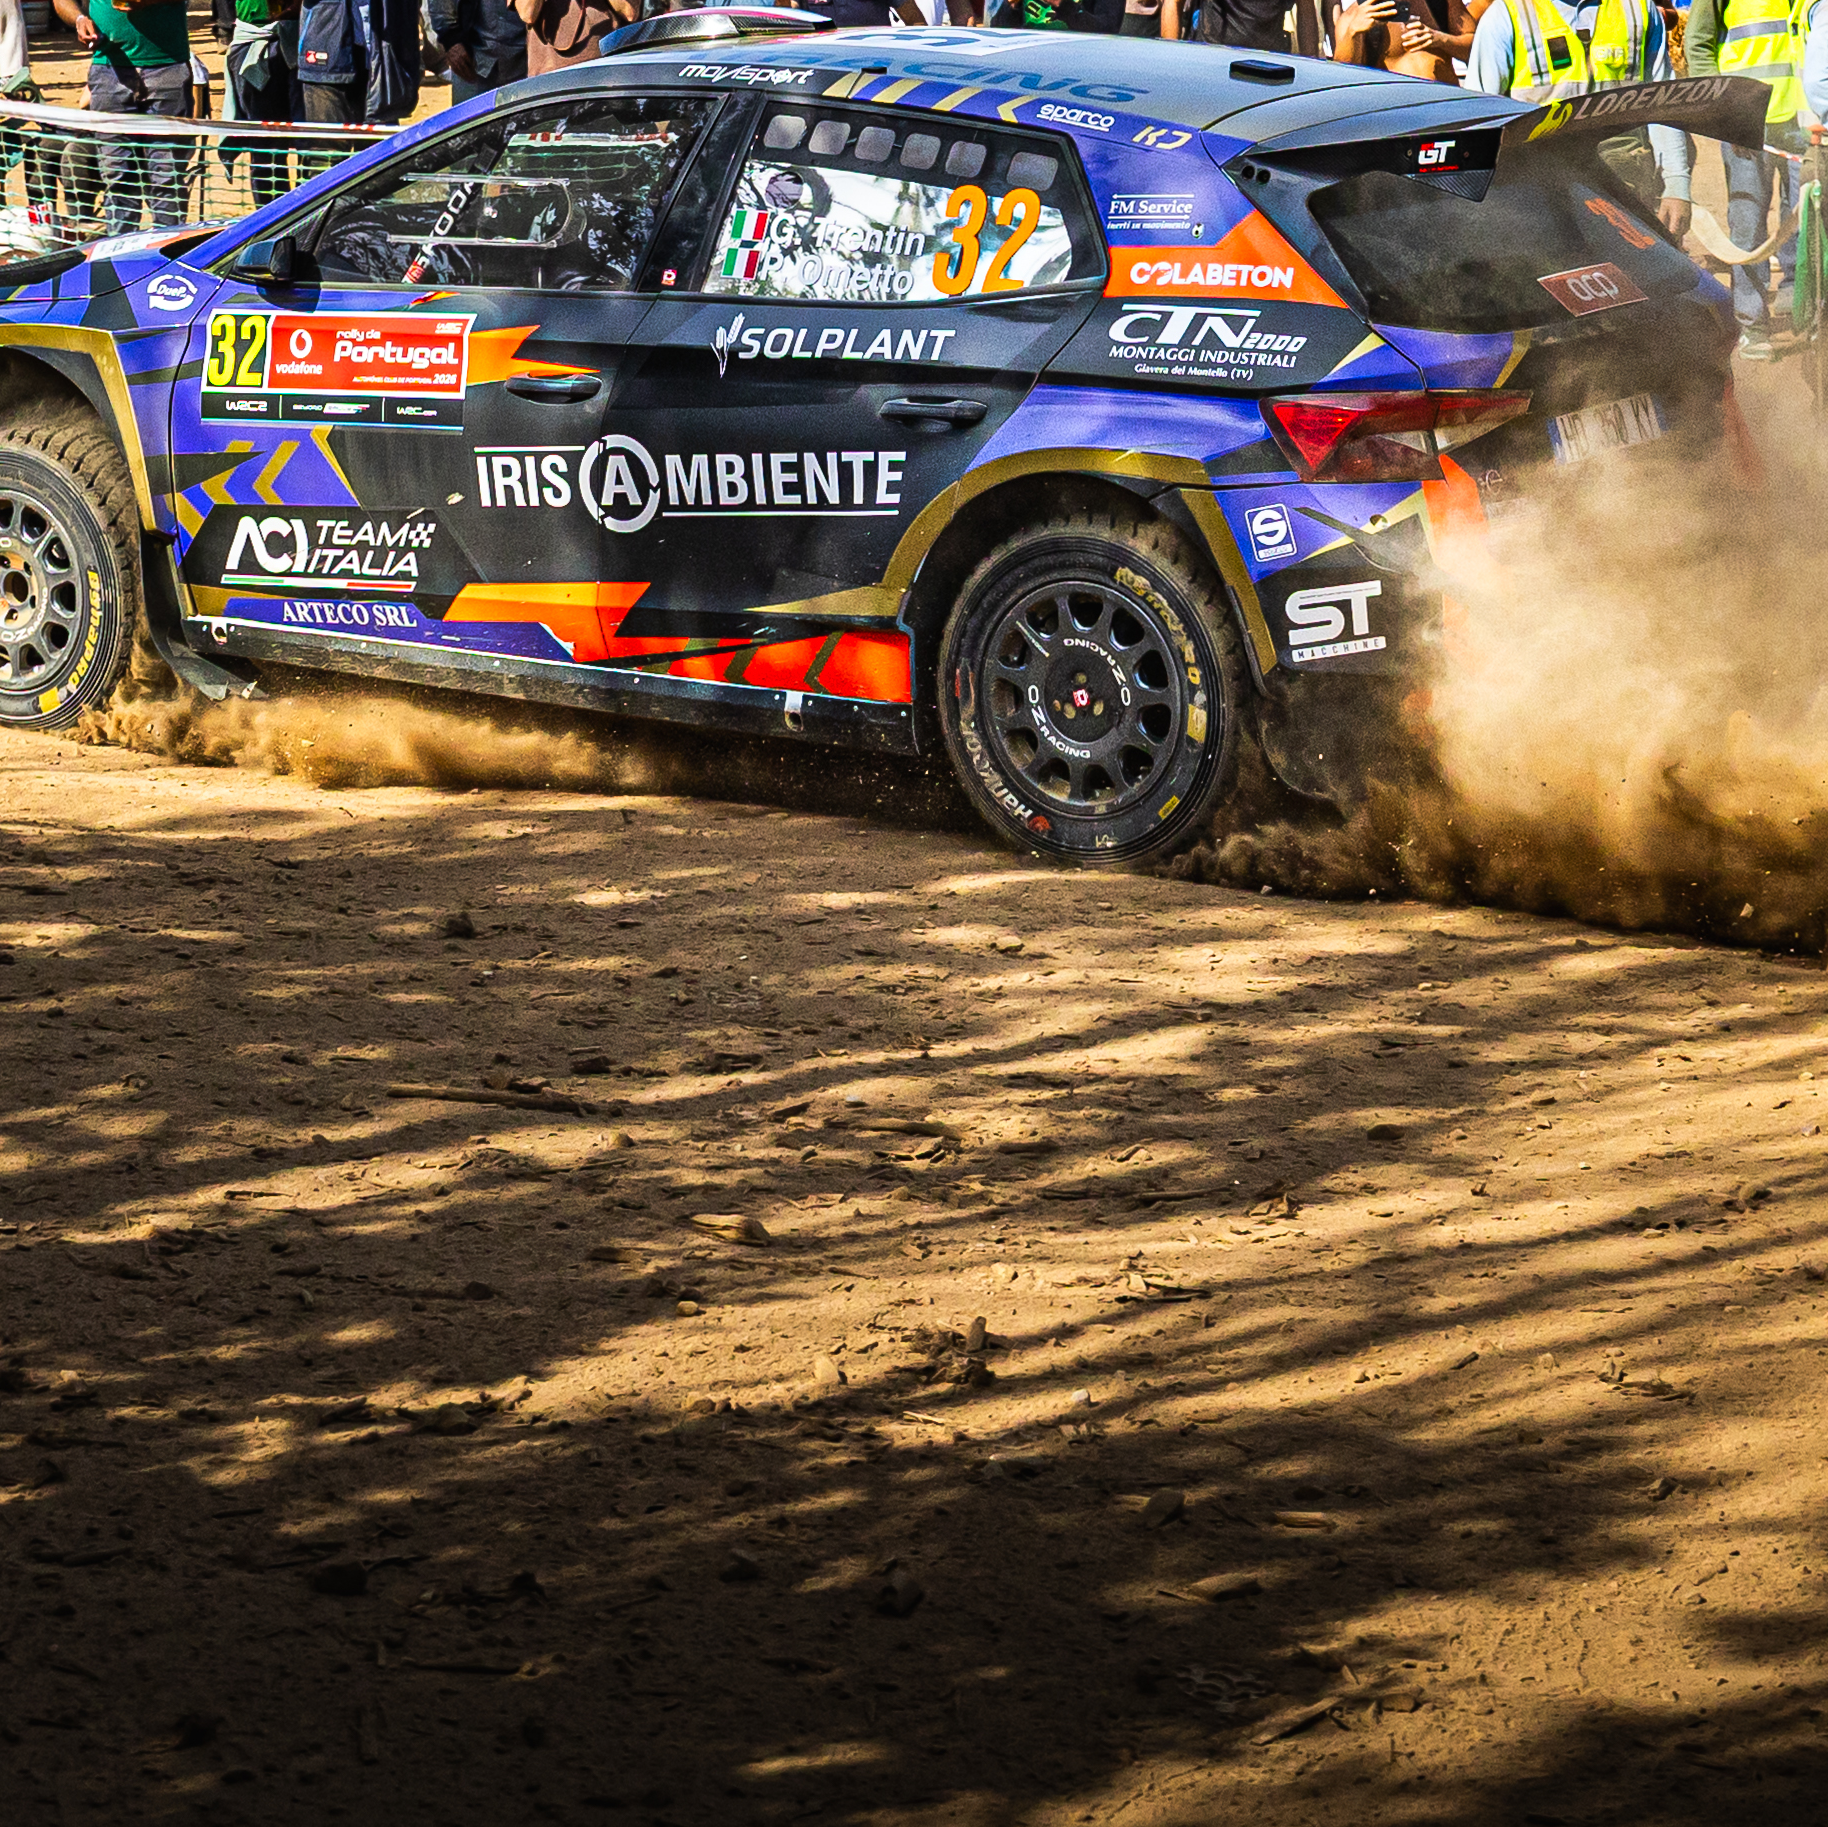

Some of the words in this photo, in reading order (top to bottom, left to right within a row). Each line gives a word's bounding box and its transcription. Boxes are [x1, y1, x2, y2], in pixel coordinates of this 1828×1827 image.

[1573, 77, 1732, 120] LORENZON
[1037, 102, 1115, 130] sparco
[1418, 140, 1456, 165] GT
[1109, 200, 1135, 215] FM
[1137, 200, 1193, 215] Service
[815, 218, 926, 257] Trentin
[932, 185, 1041, 295] 32
[800, 255, 913, 295] Ometto
[1130, 261, 1294, 289] COLABETON
[1567, 271, 1620, 303] acp
[336, 329, 364, 341] rally
[1108, 303, 1262, 348] CTN
[1242, 332, 1308, 353] 2000
[207, 314, 266, 386] 32
[333, 340, 459, 370] Portugal
[739, 327, 956, 361] SOLPLANT
[1108, 345, 1196, 363] MONTAGGI
[1199, 349, 1297, 368] INDUSTRIALI
[275, 362, 323, 375] vodafone
[1171, 364, 1186, 376] del
[1230, 368, 1254, 381] (TV)
[475, 453, 573, 508] IRIS
[315, 520, 408, 549] TEAM
[306, 549, 421, 577] ITALIA
[281, 602, 369, 626] ARTECO
[372, 604, 418, 628] SRL
[1285, 580, 1382, 645] ST
[1297, 638, 1381, 660] MACCHINE
